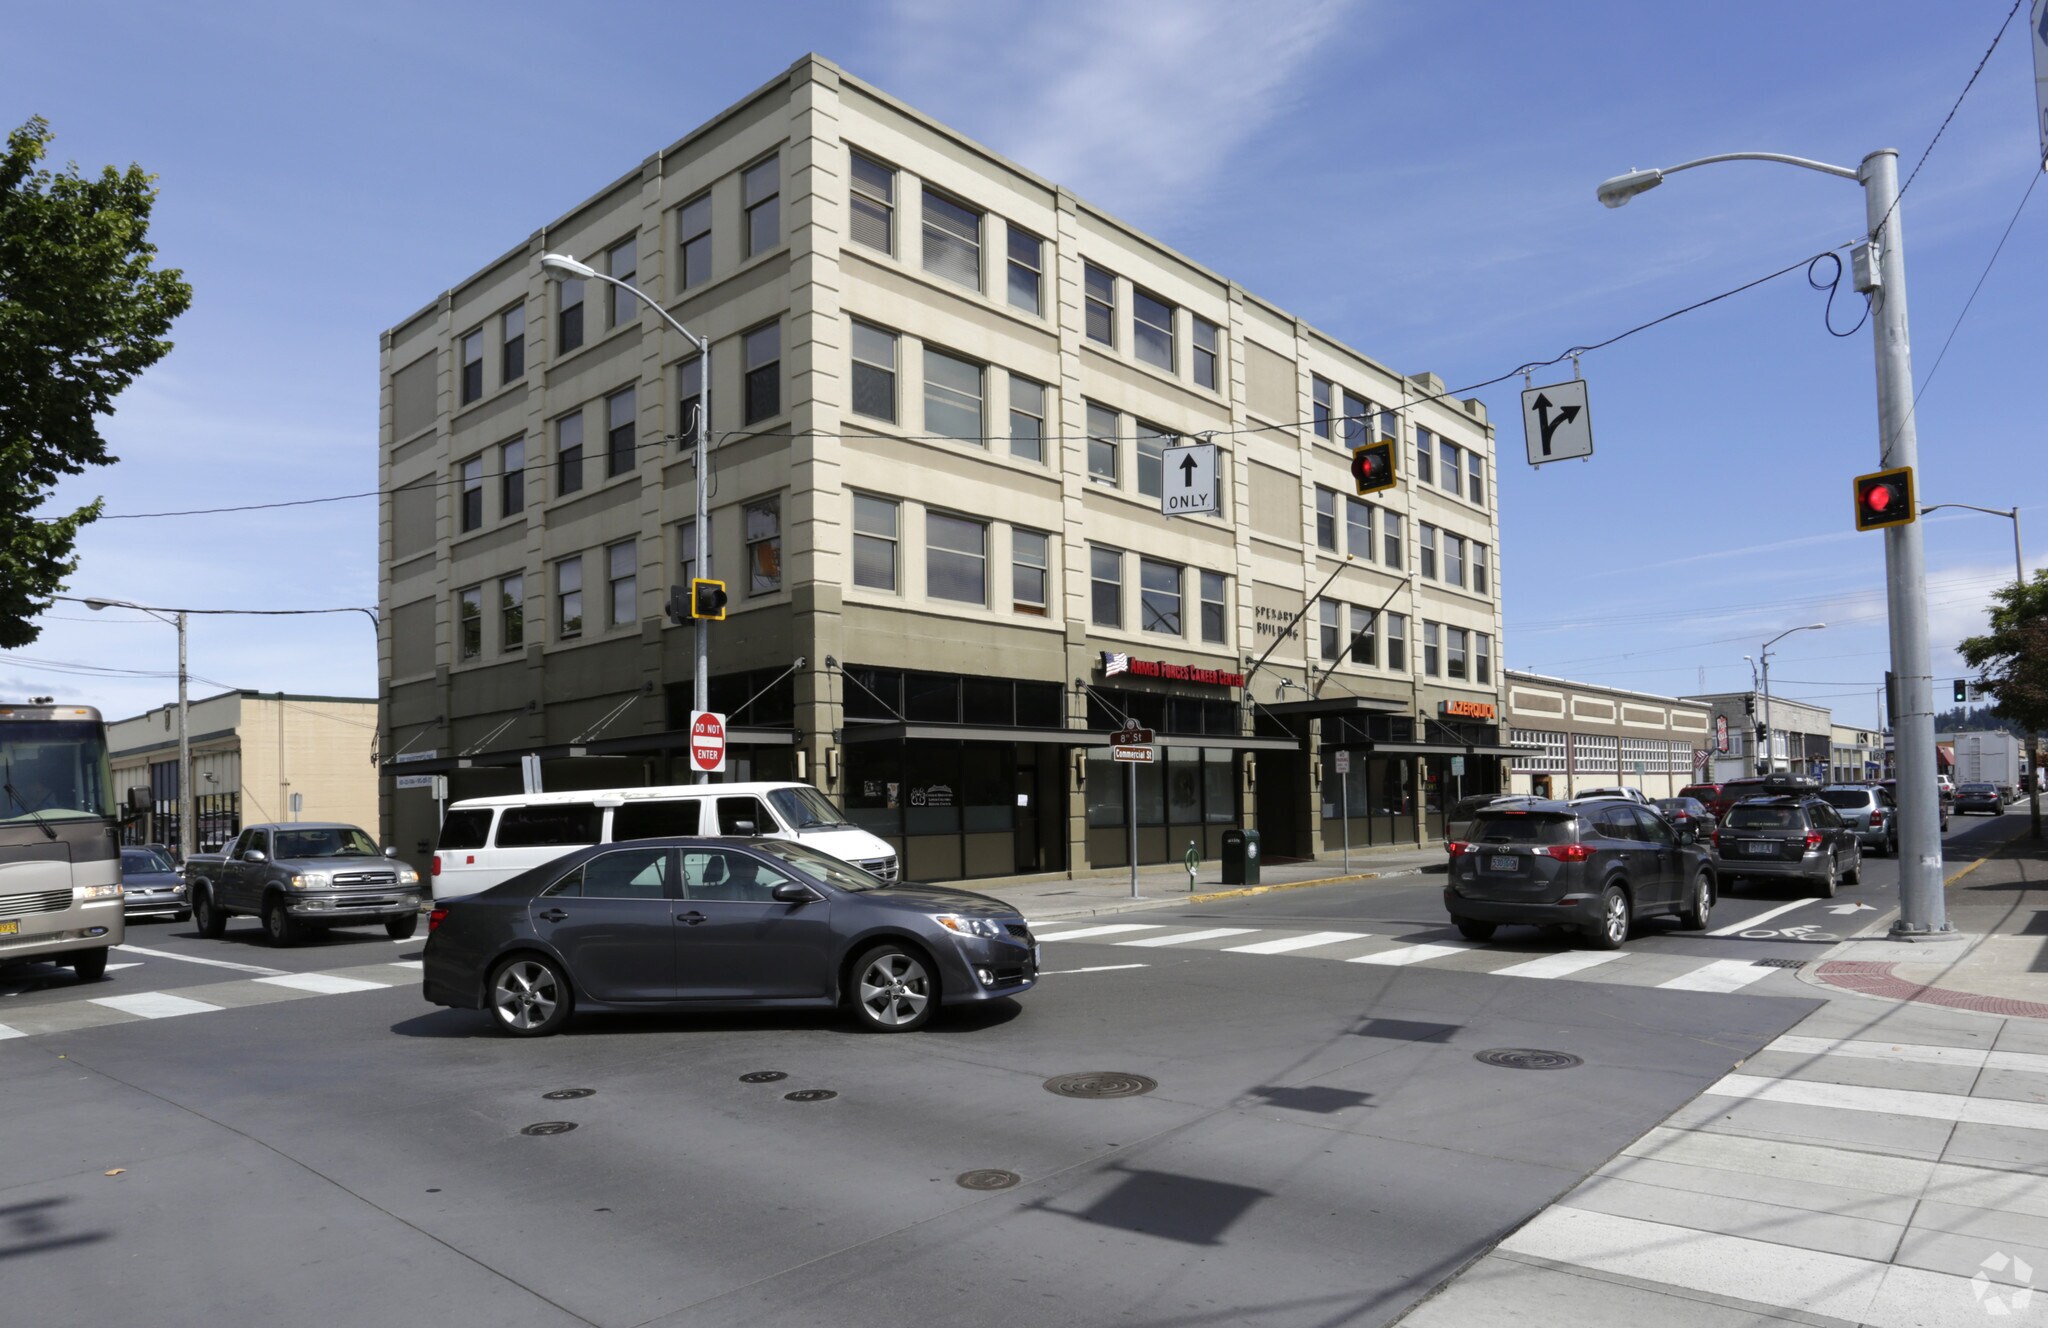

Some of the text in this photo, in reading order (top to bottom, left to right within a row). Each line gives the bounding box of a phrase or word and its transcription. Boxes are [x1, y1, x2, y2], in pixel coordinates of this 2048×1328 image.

[1169, 493, 1208, 509] ONLY
[1130, 657, 1244, 688] ARMED FORCES CAREER CENTER
[1446, 699, 1497, 720] LAZERQUICK
[695, 723, 720, 735] DO NOT
[1133, 733, 1142, 742] St
[697, 749, 719, 760] ENTER
[1116, 748, 1152, 759] Commercial St
